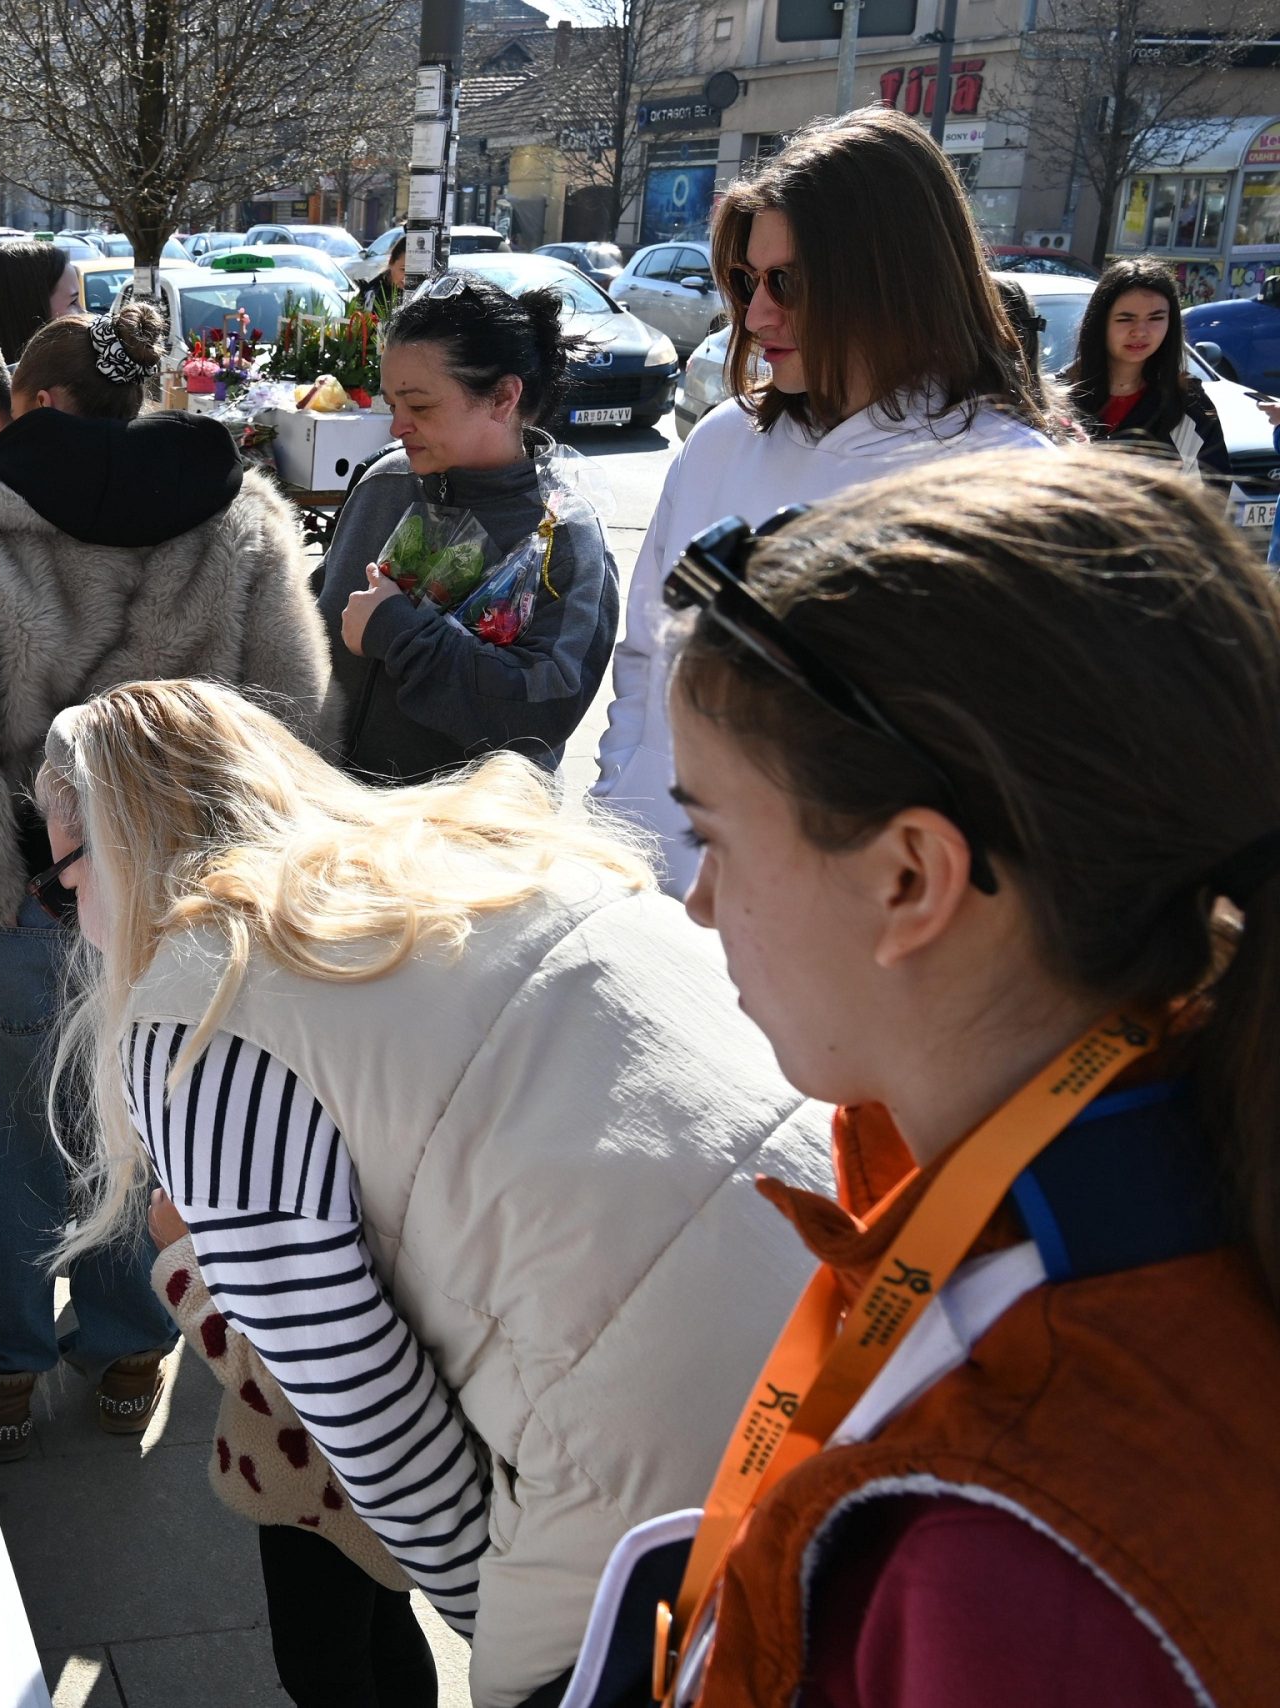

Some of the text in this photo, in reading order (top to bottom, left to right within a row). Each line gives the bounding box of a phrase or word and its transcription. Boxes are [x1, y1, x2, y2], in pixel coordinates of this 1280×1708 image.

[945, 133, 968, 141] SONY
[577, 411, 589, 422] AR
[1247, 505, 1267, 523] AR
